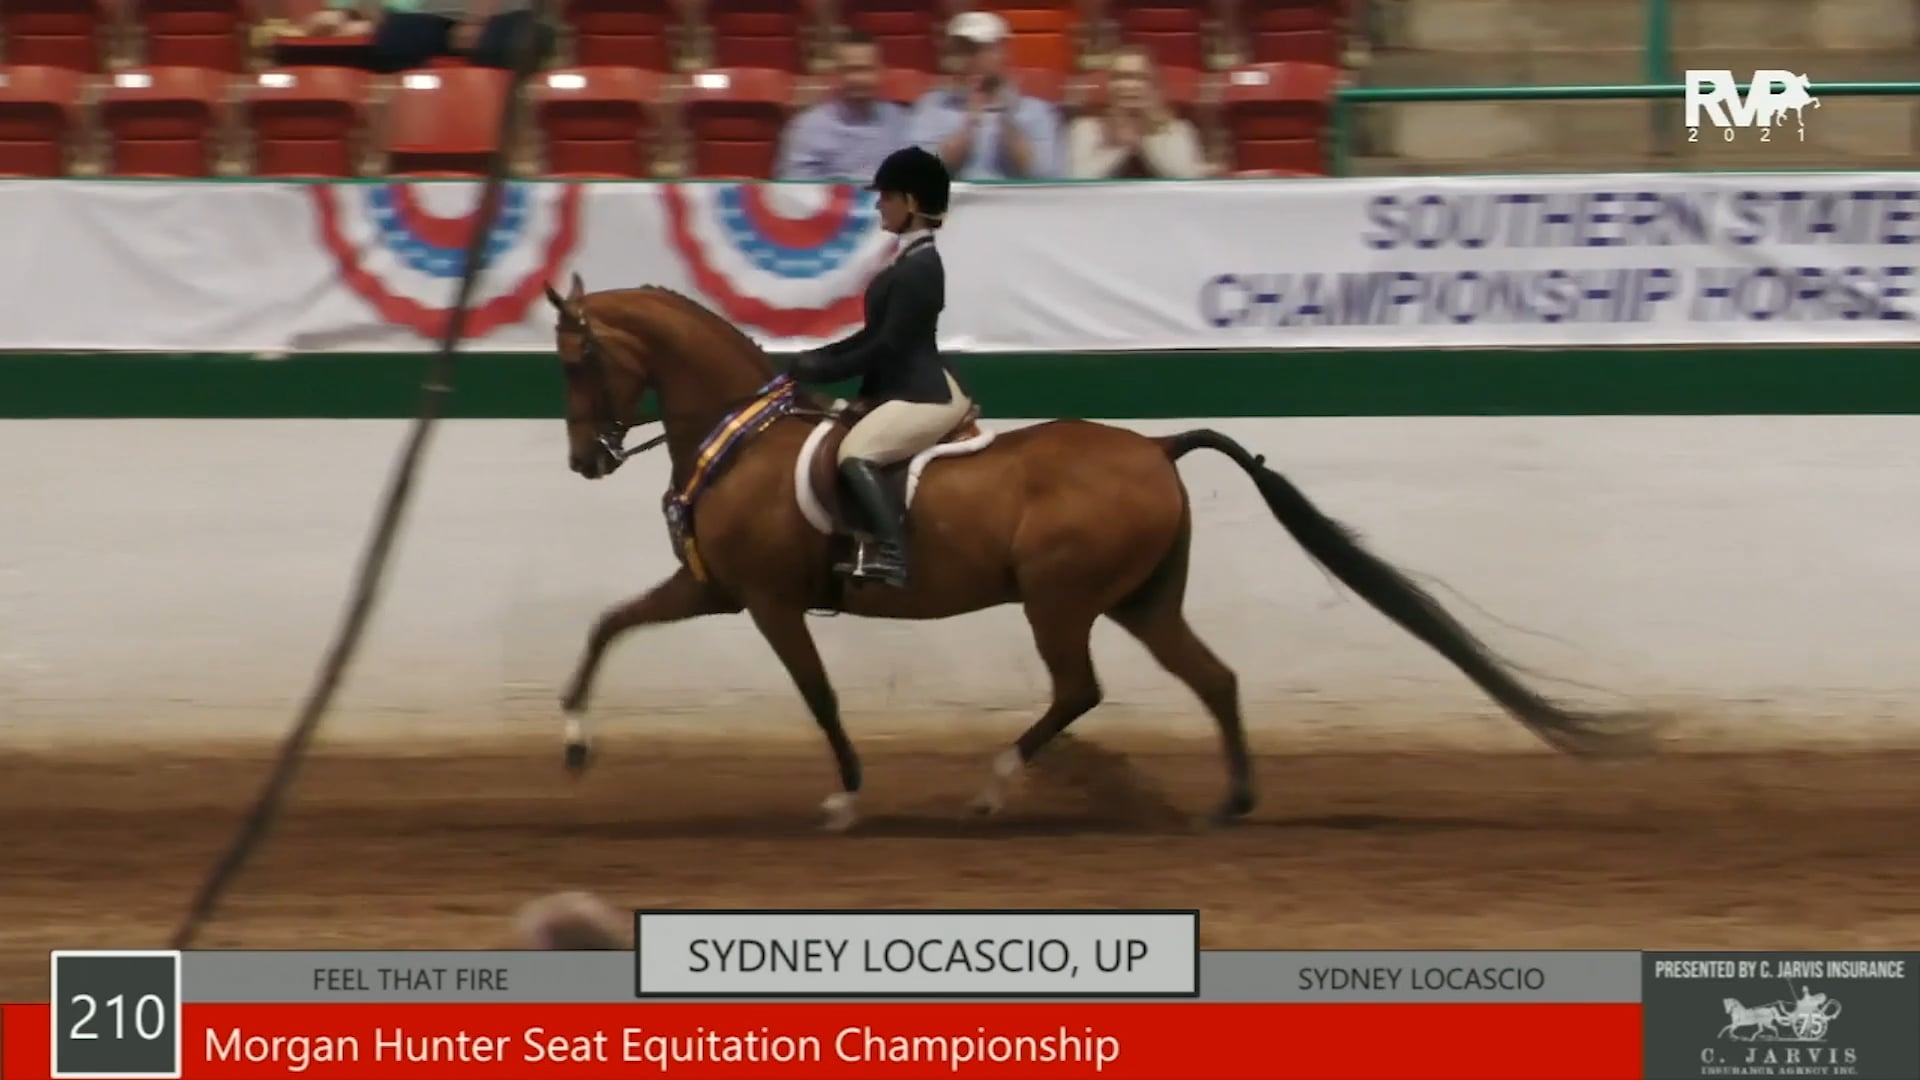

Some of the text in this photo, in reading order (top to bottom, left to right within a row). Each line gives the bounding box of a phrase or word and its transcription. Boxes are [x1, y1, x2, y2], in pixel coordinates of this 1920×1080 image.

[1365, 193, 1707, 249] SOUTHERN
[1201, 266, 1918, 328] CHAMPIONSHIP HORSE
